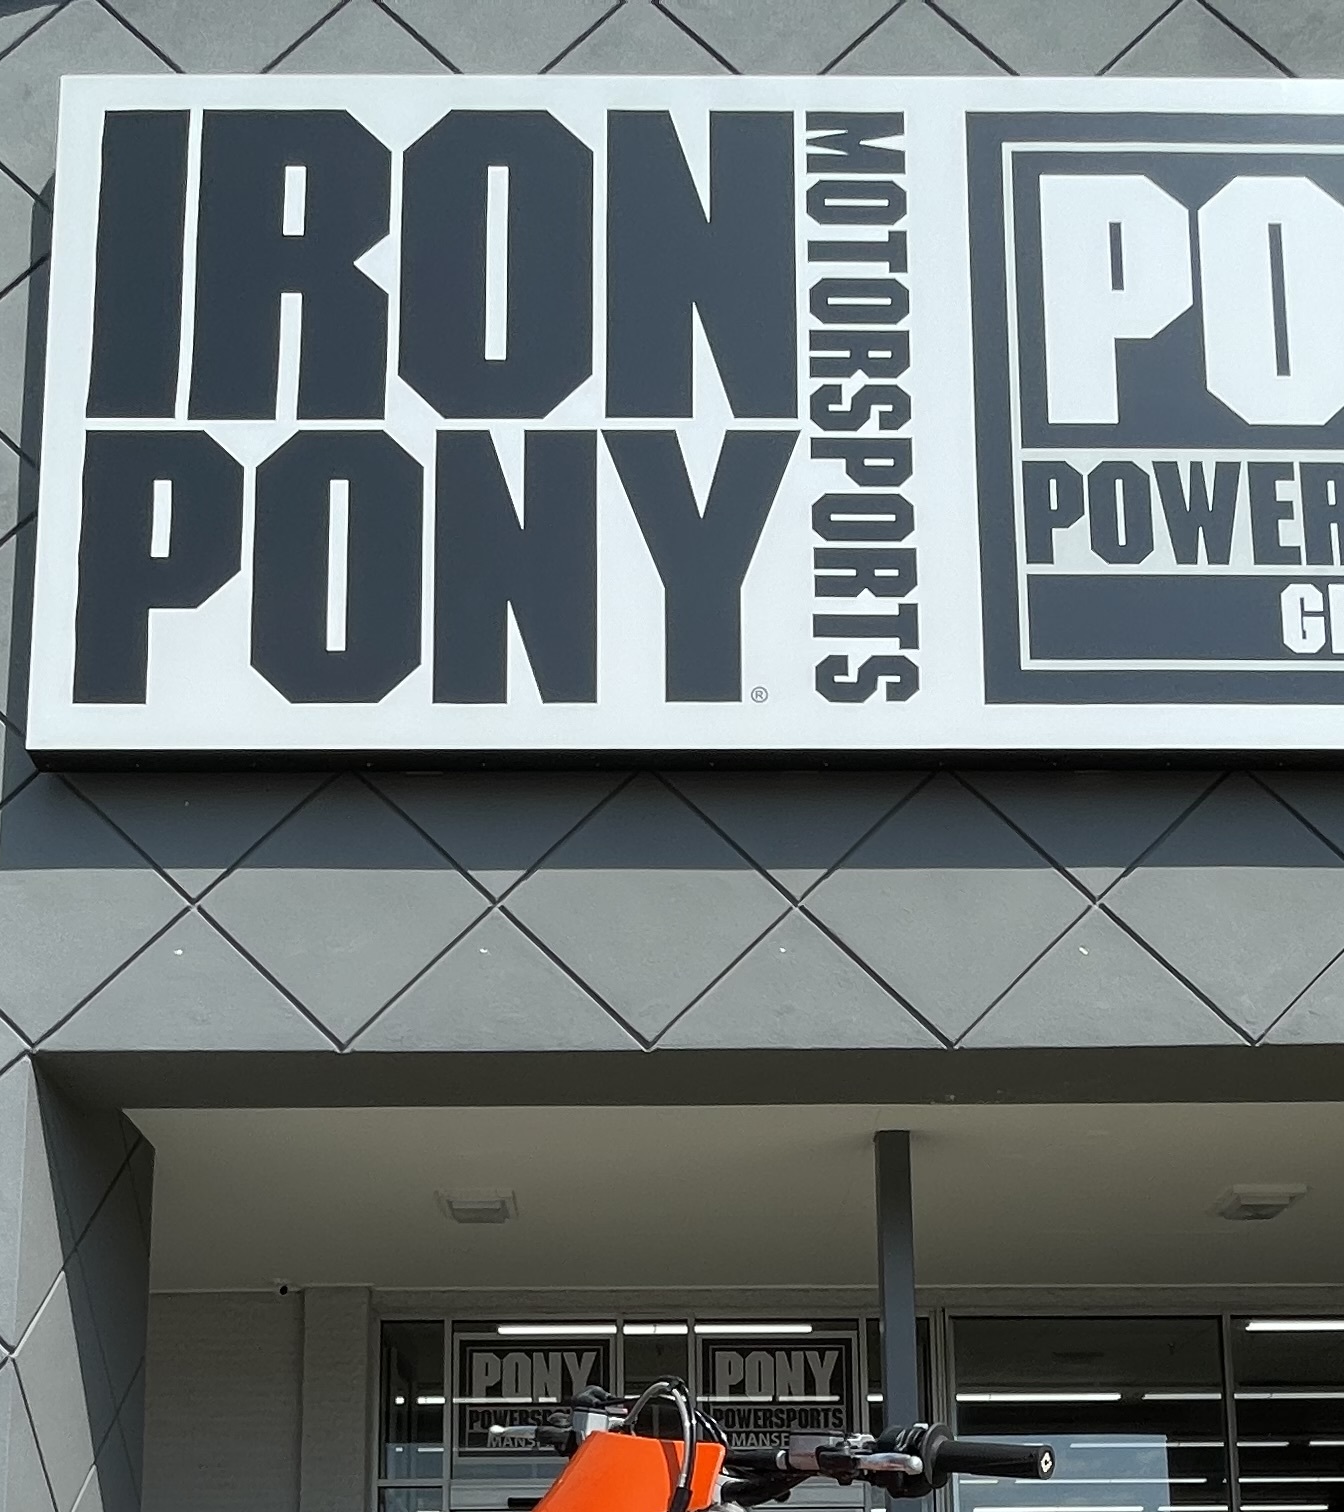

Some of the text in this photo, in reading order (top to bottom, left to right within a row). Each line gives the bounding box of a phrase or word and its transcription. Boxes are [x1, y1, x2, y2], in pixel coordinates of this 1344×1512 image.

[86, 109, 798, 420] IRON
[806, 111, 919, 703] MOTORSPORTS
[72, 429, 801, 704] PONY
[472, 1351, 597, 1403] PONY
[715, 1351, 839, 1400] PONY
